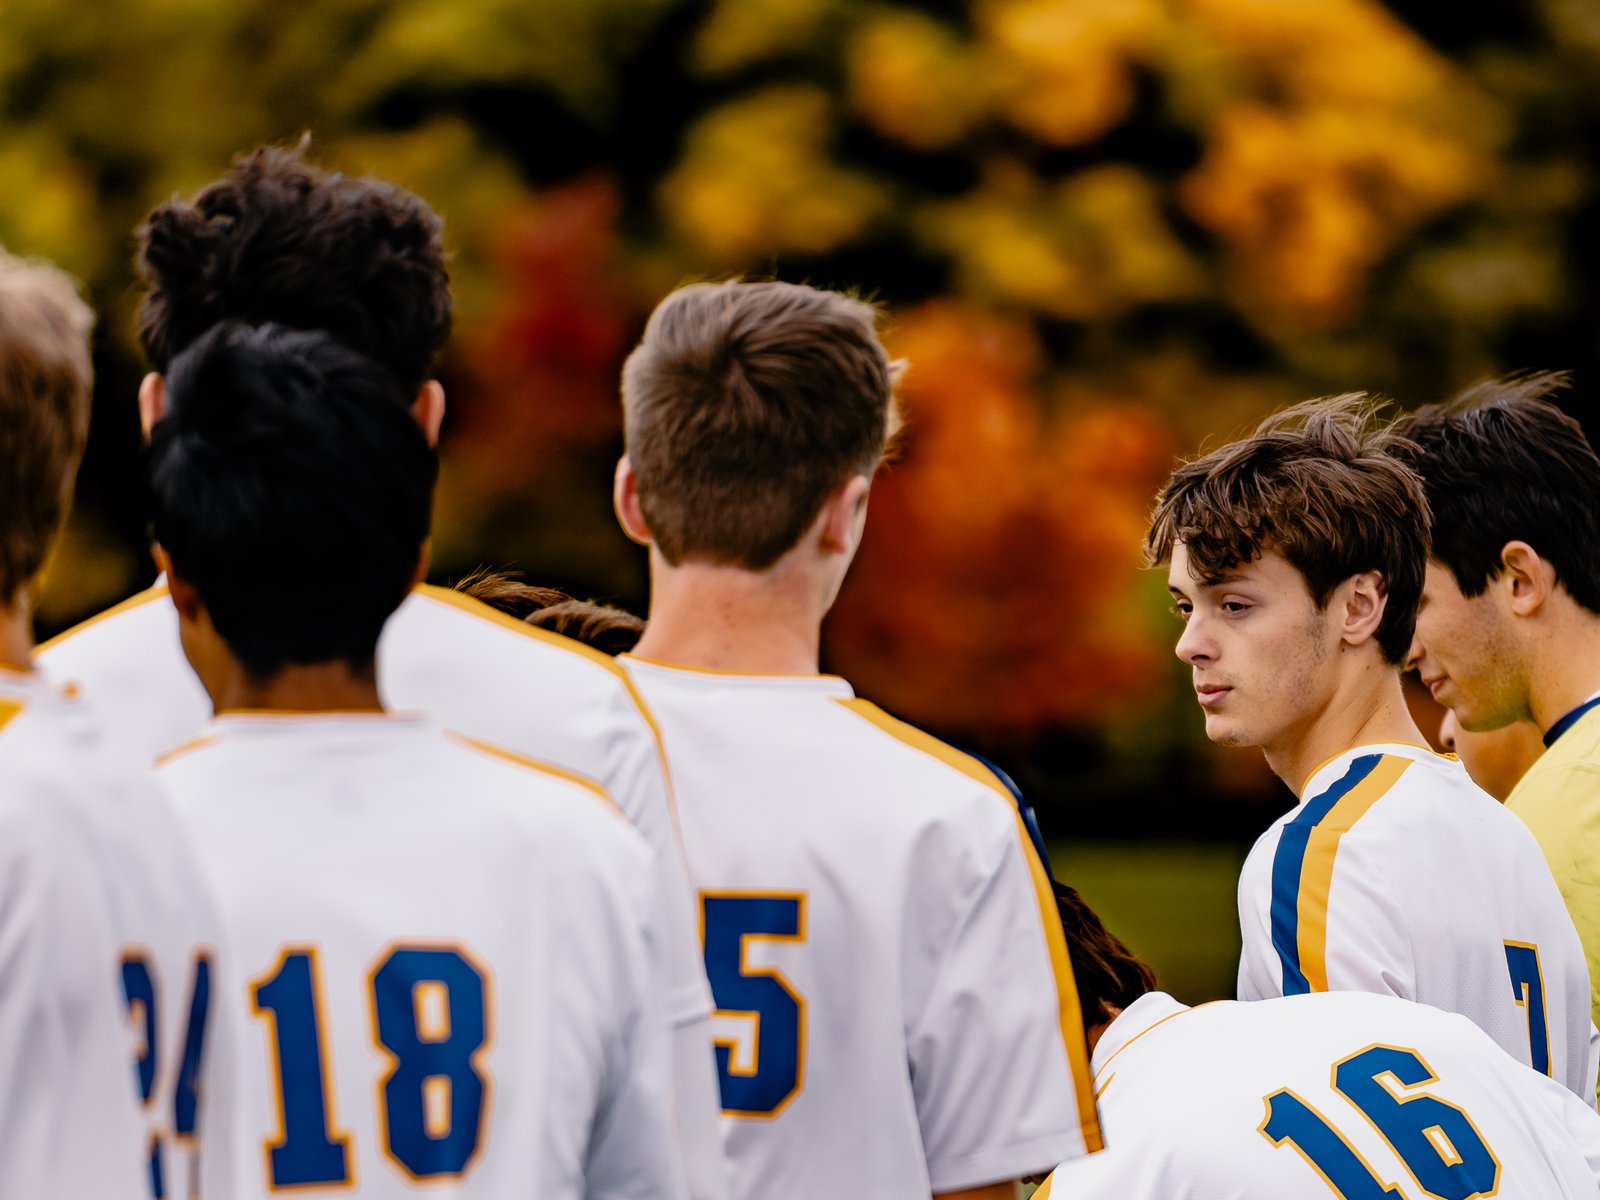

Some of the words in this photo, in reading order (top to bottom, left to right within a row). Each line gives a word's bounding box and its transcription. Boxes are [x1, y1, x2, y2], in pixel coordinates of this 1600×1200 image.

[246, 938, 495, 1197] 18
[697, 888, 807, 1121] 5
[1503, 939, 1552, 1079] 7
